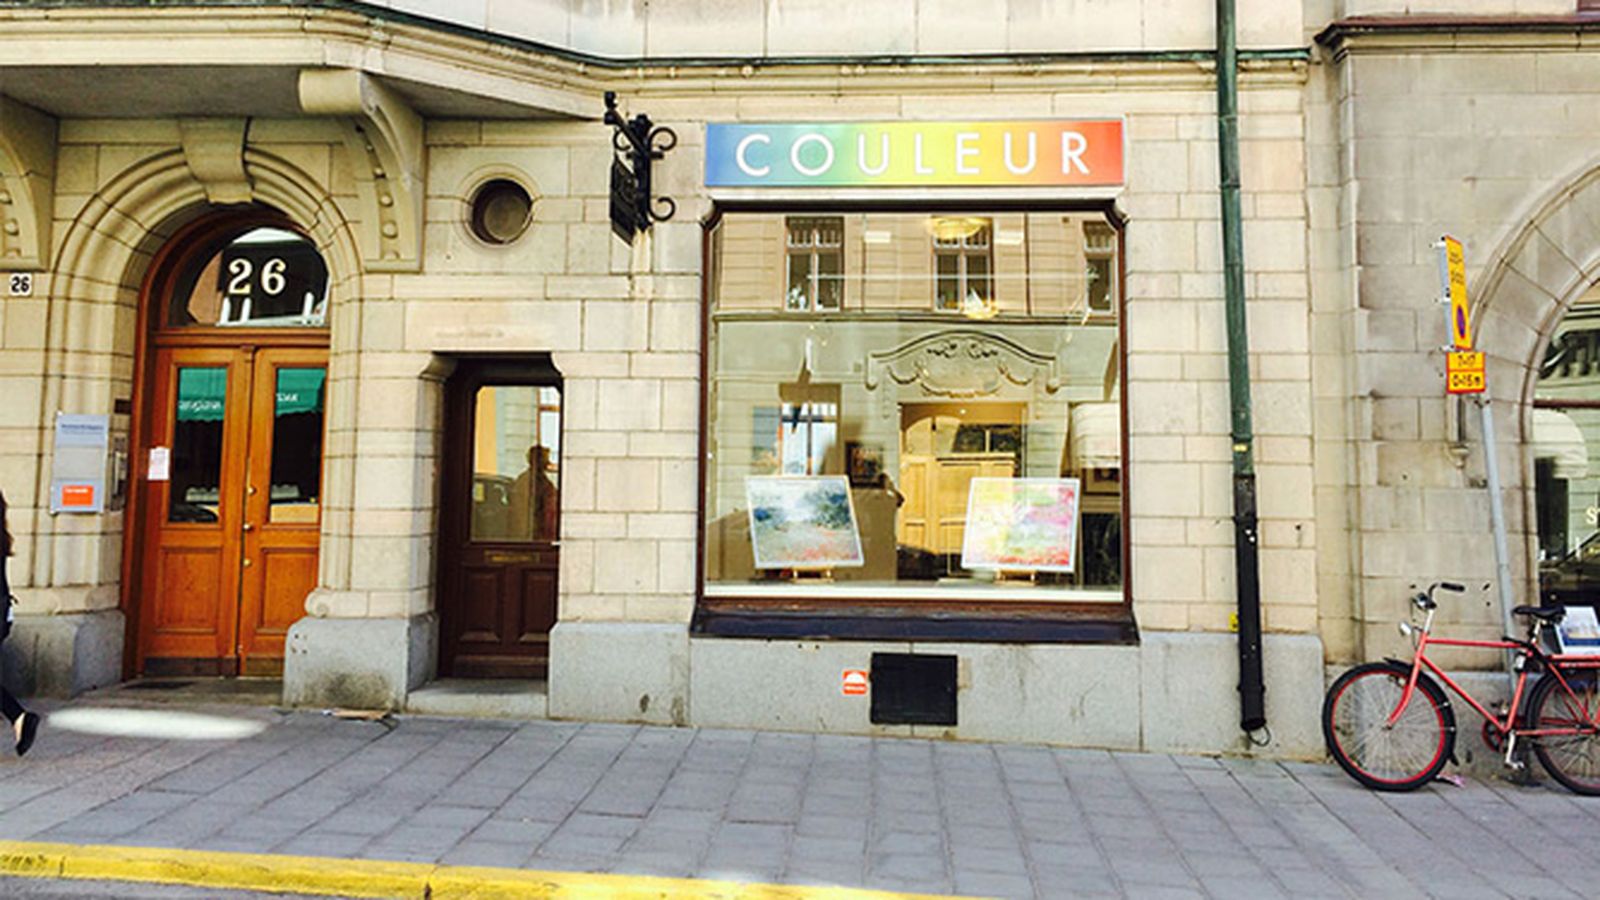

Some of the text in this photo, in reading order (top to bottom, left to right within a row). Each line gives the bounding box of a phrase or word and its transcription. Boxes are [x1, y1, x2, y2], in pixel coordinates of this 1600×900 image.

[736, 131, 1090, 177] COULEUR
[11, 275, 30, 293] 26
[228, 257, 287, 296] 26
